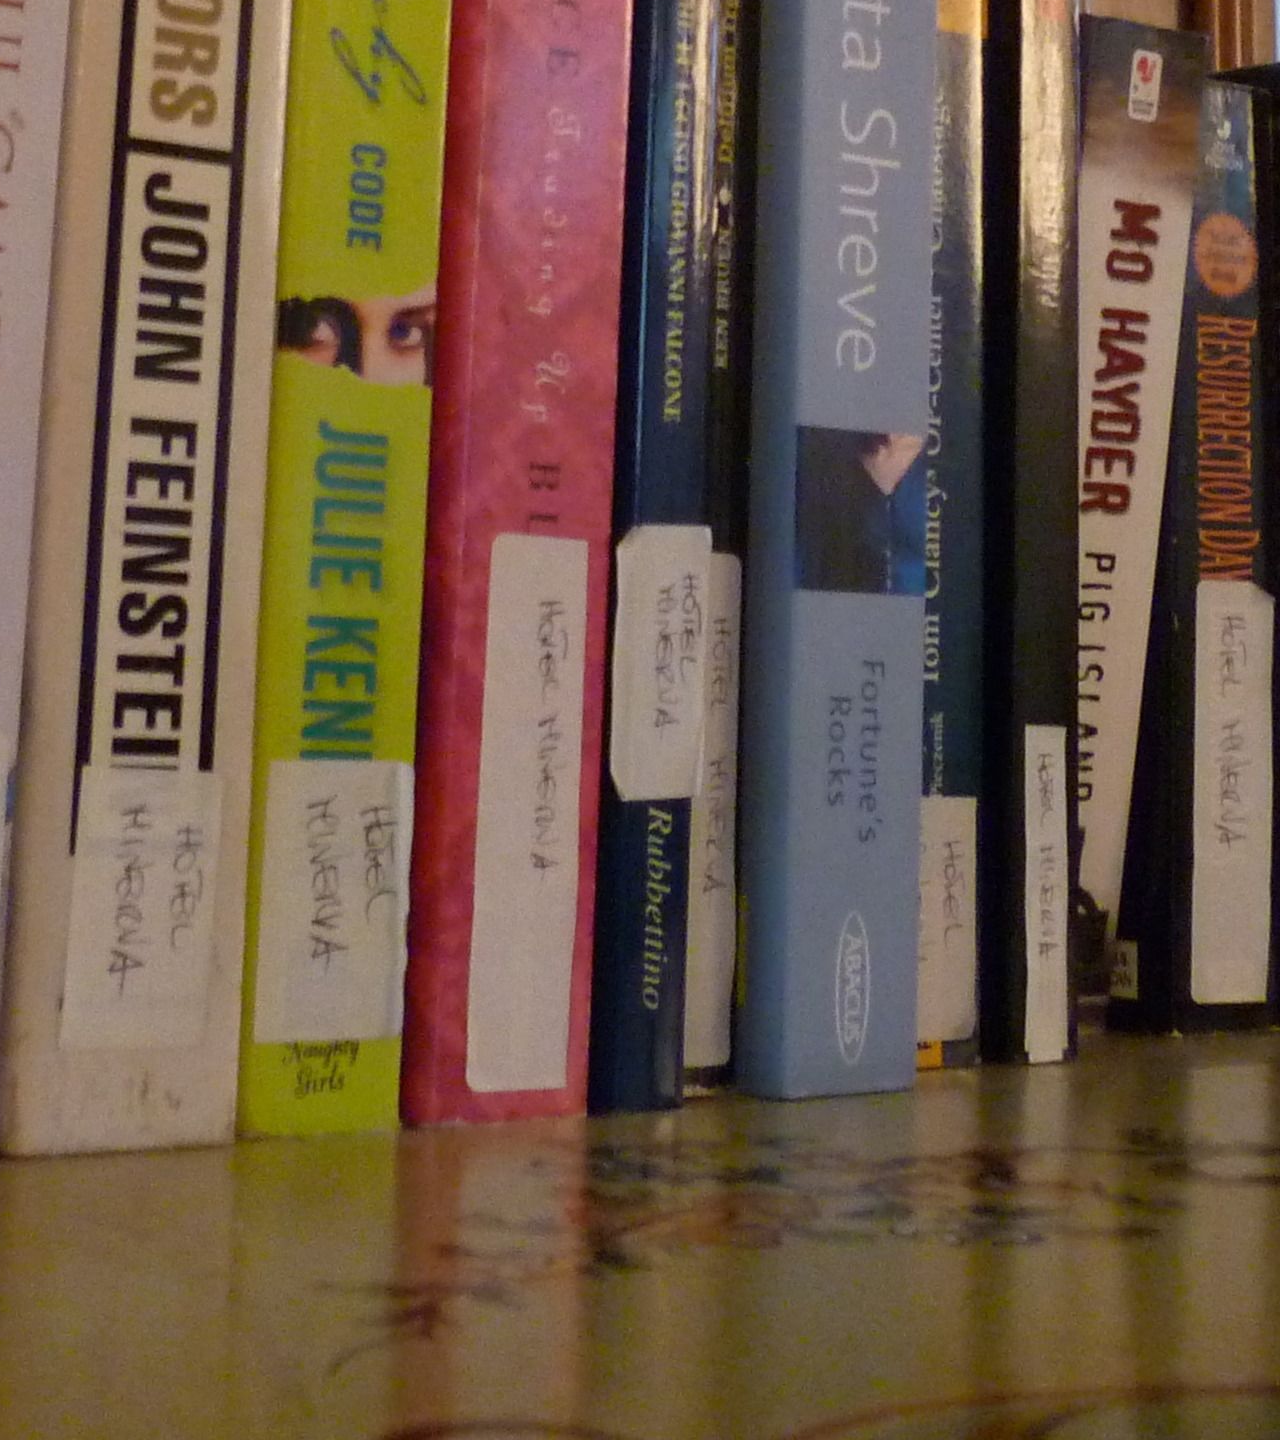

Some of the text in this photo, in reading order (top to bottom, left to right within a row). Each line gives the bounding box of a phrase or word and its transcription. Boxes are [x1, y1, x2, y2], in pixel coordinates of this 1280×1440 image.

[133, 172, 211, 386] JOHN
[345, 143, 387, 253] CODE
[836, 102, 901, 373] Shreve
[663, 309, 685, 423] FALCONE
[1079, 199, 1161, 517] MO HAYDER
[1196, 314, 1258, 523] RESURRECTION
[307, 420, 390, 595] JULIE
[1078, 552, 1117, 622] PIG
[827, 695, 852, 807] Rocks
[858, 660, 885, 843] Fortune's
[642, 807, 673, 1010] Rubbettino
